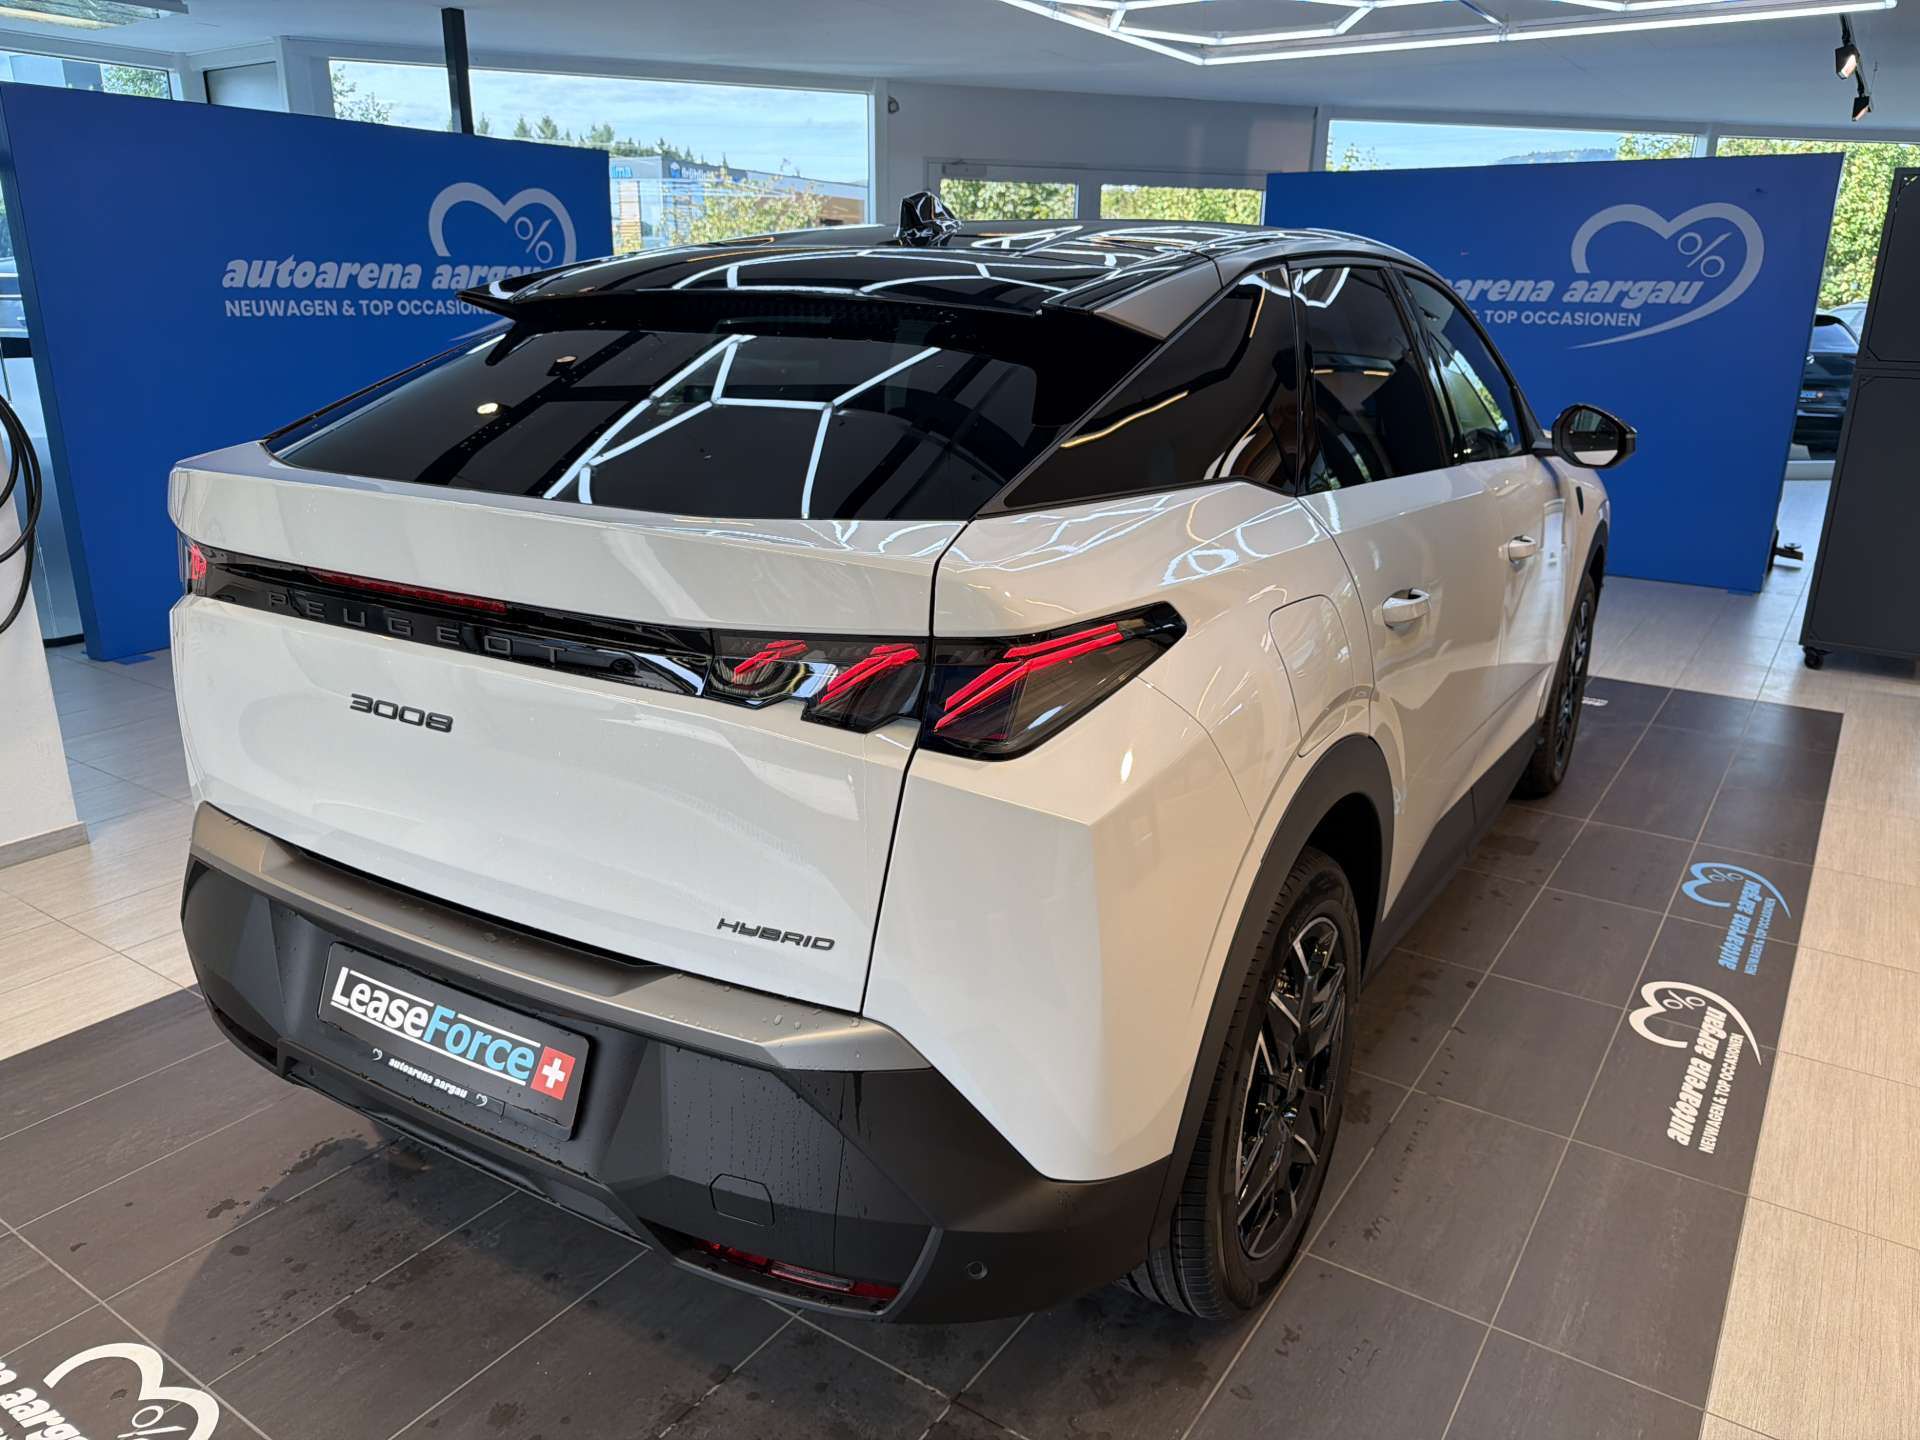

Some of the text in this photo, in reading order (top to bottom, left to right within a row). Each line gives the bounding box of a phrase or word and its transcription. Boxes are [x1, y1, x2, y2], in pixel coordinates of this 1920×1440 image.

[514, 216, 554, 264] %
[1677, 231, 1733, 278] %
[222, 254, 542, 290] autoarena aar
[1444, 278, 1705, 310] arena aargau
[225, 299, 494, 317] NEUWAGEN & TOP OCCASION
[1485, 310, 1517, 325] TOP
[1521, 310, 1641, 327] OCCASIONEN
[268, 592, 567, 664] PEUGEOT
[350, 693, 453, 733] 3008
[716, 918, 836, 951] HYBRID
[1718, 880, 1762, 971] autoarena aargau
[1662, 989, 1706, 1010] %
[331, 966, 536, 1080] LeaseForce
[388, 1058, 468, 1099] autoarena aargau
[1666, 1006, 1728, 1146] autoarena aargau
[1698, 1033, 1745, 1154] NEUWAGEN & TOP OCCASIONEN
[0, 1387, 89, 1440] aarg
